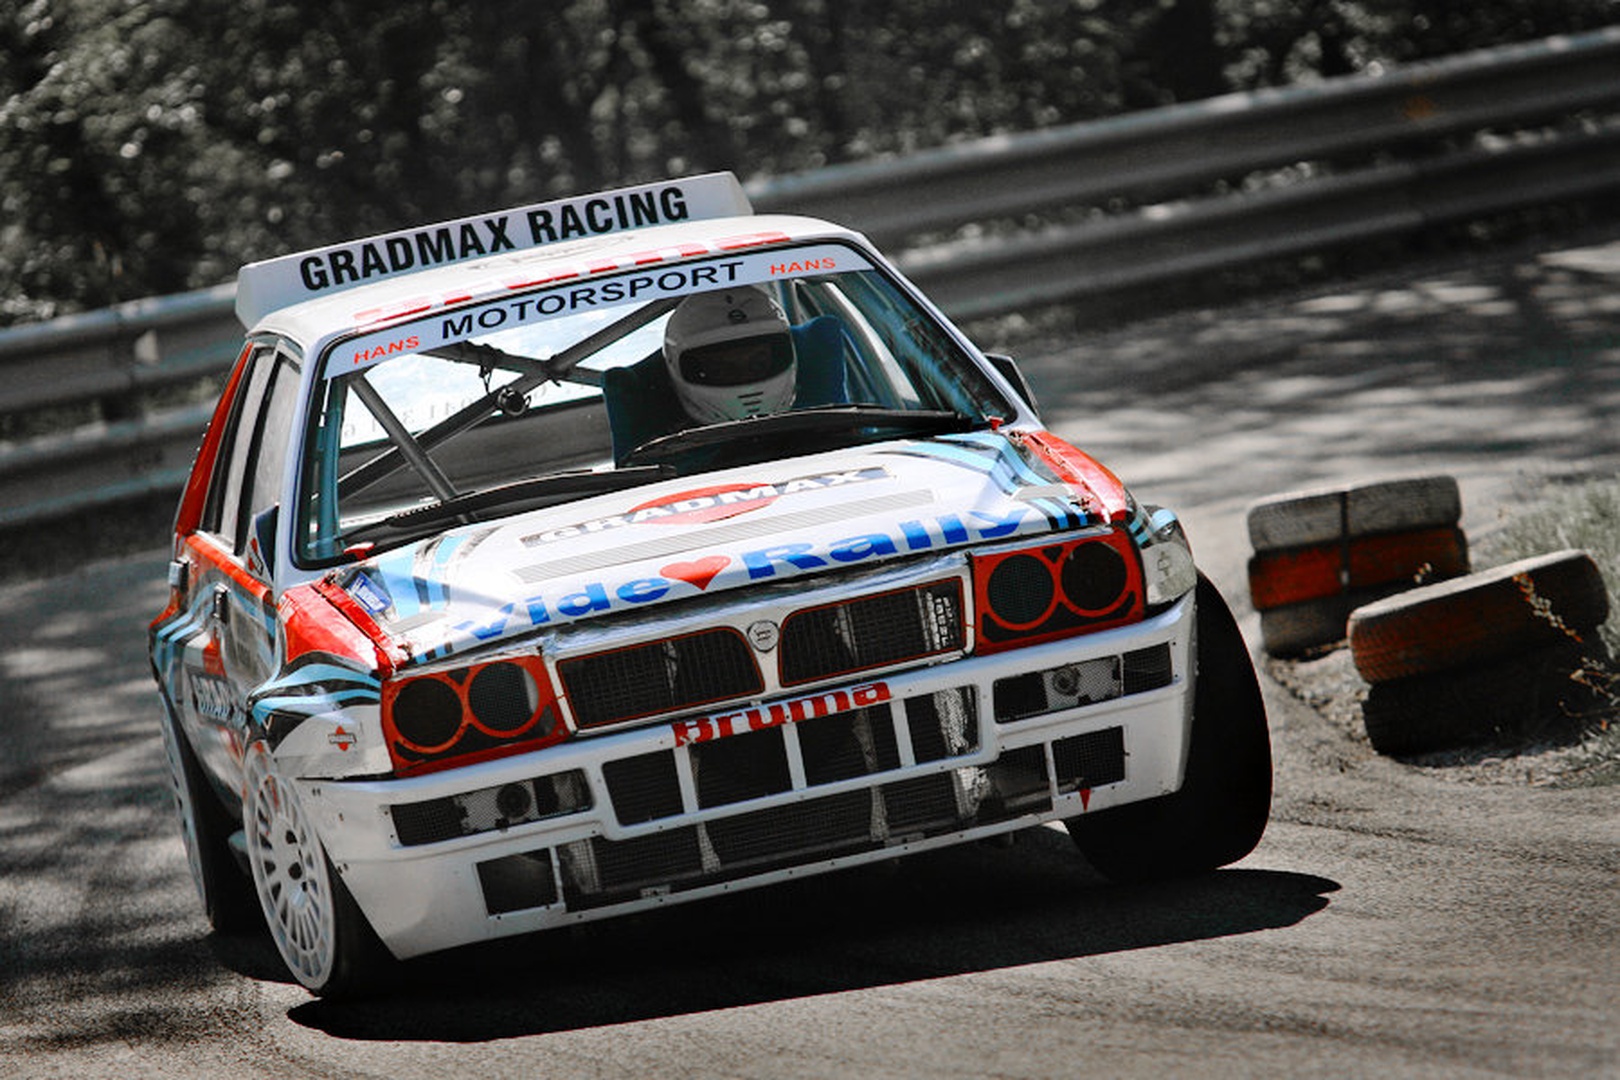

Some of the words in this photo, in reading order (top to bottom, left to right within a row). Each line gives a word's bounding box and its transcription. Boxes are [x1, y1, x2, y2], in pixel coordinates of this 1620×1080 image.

[300, 215, 518, 291] GRADMAX
[527, 186, 689, 245] RACING
[354, 335, 420, 365] HANS
[441, 261, 745, 340] MOTORSPORT
[770, 257, 836, 275] HANS
[538, 470, 865, 543] GRADMAX
[742, 508, 1031, 580] Rally
[671, 681, 892, 748] Bruma
